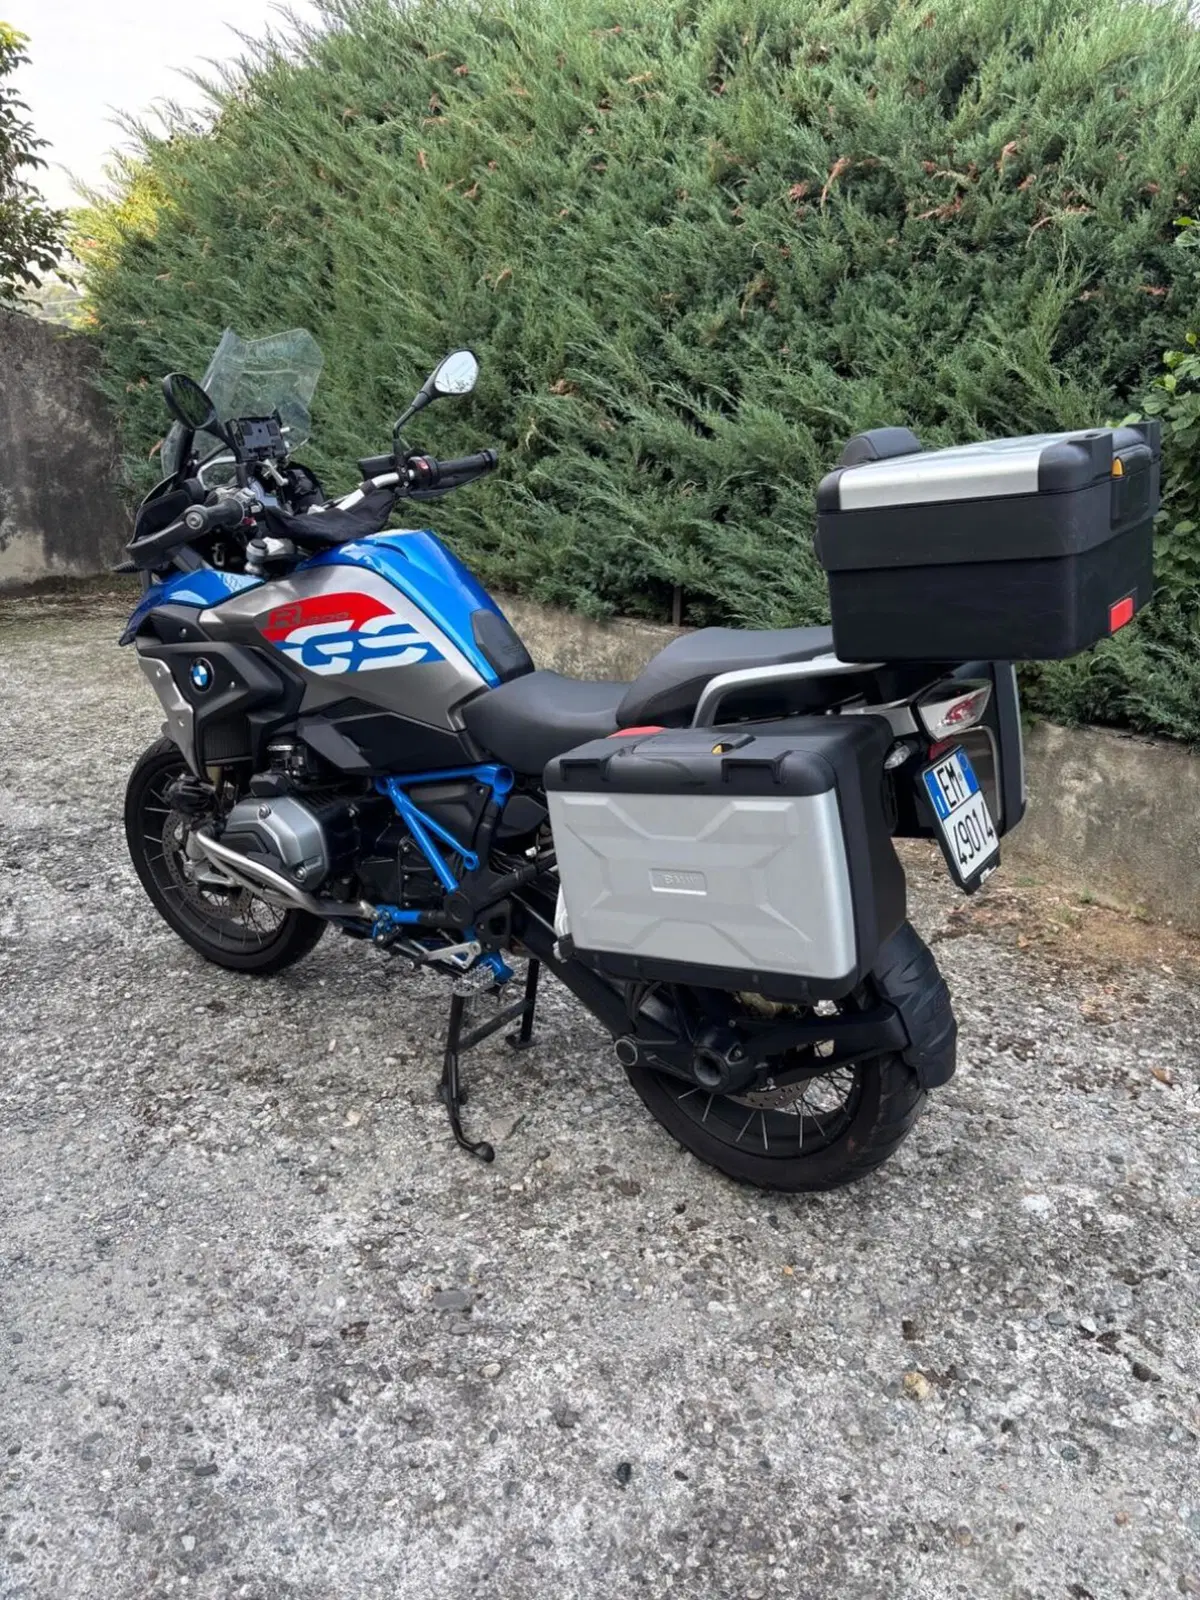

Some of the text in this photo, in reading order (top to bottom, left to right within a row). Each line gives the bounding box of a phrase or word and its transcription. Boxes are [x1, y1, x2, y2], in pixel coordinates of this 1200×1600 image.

[282, 613, 430, 676] GS
[937, 761, 965, 809] EM
[952, 801, 994, 865] 49014
